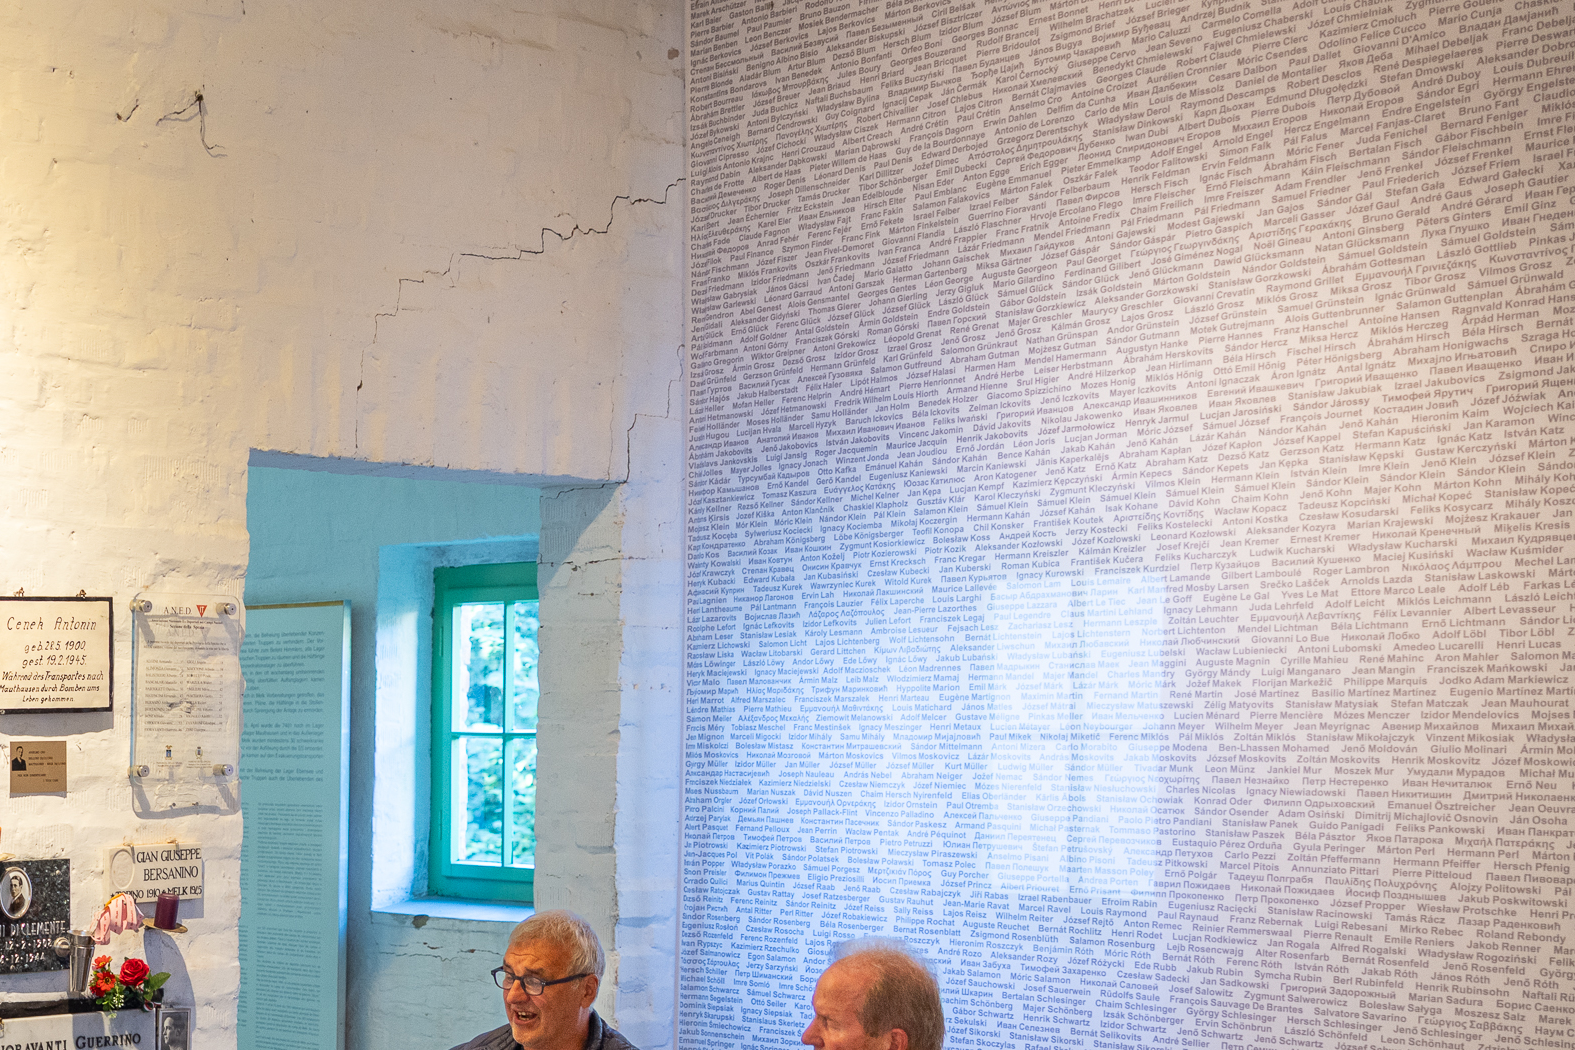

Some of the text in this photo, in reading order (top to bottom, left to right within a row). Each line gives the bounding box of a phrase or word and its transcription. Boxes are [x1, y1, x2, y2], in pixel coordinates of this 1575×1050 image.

[1354, 30, 1446, 55] Giovanni D'Amico
[1339, 52, 1393, 68] Яков Деба
[1373, 46, 1483, 74] René Despiegelaeres
[1380, 61, 1464, 84] Stefan Dmowski
[1412, 70, 1481, 90] André Duboy
[753, 583, 802, 592] Tadeusz Kurek
[54, 617, 97, 630] Antonin
[1430, 745, 1507, 754] Giulio Molinari
[1387, 800, 1496, 812] Emanuel Ösztreicher
[1396, 824, 1485, 835] Feliks Pankowski
[137, 848, 201, 863] GIAN GIUSEPPE
[144, 866, 198, 881] BERSANINO
[76, 1033, 141, 1049] GUERRINO
